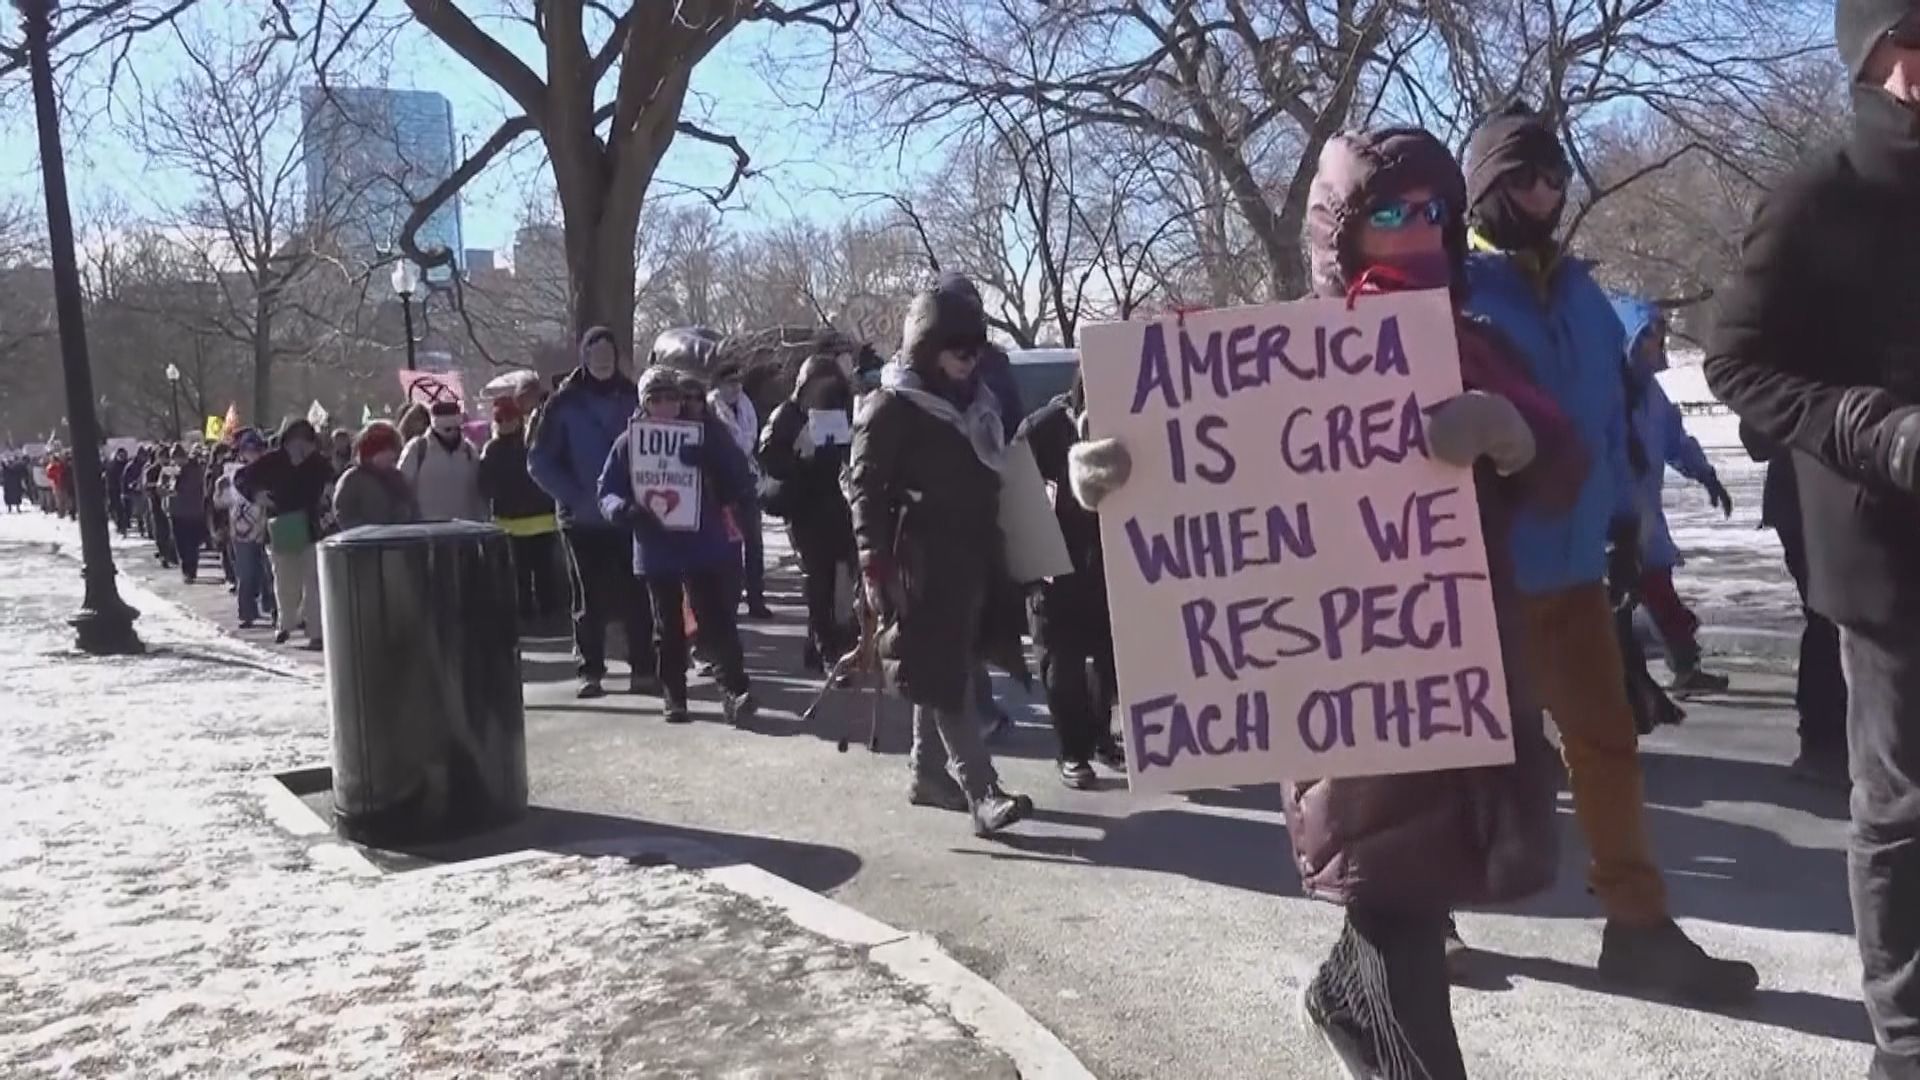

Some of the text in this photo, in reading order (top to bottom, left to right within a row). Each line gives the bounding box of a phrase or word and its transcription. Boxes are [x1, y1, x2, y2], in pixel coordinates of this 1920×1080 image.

[1130, 315, 1410, 414] AMERICA
[1166, 416, 1236, 484] IS
[1125, 487, 1466, 584] WHEN WE
[1181, 571, 1487, 680] RESPECT
[1130, 666, 1508, 772] EACH OTHER
